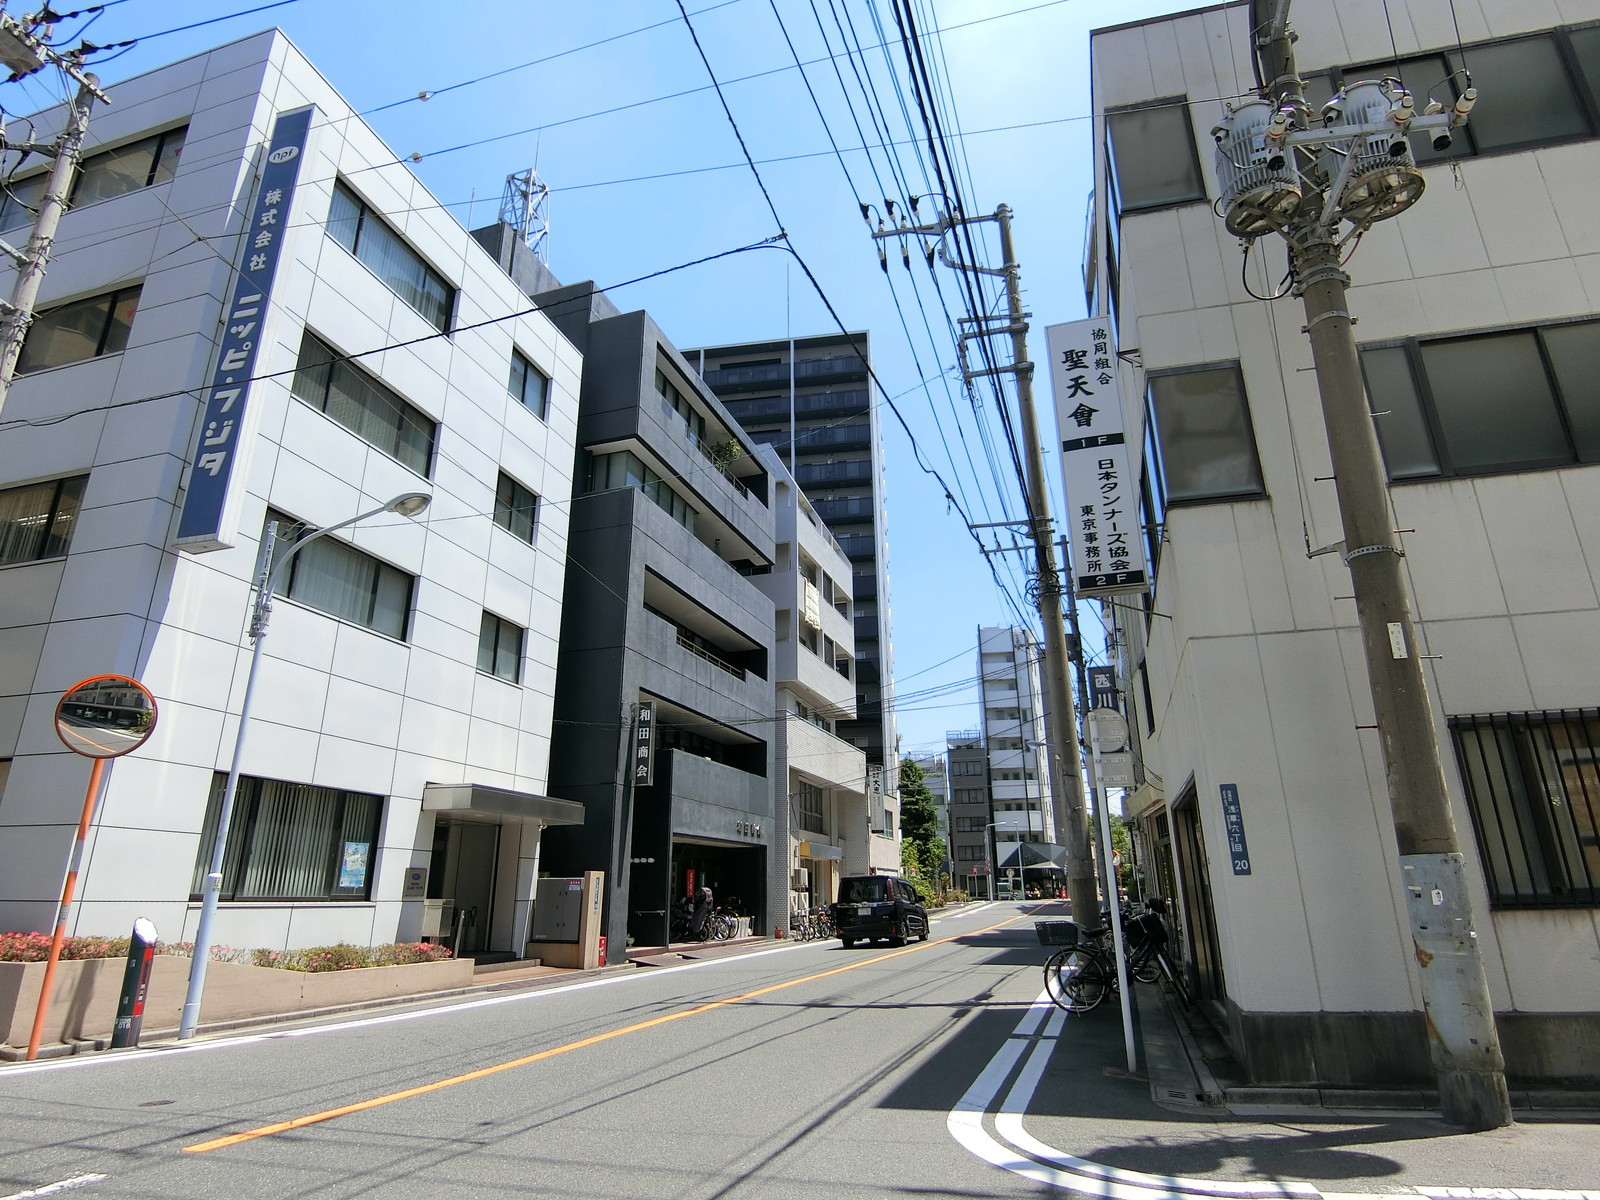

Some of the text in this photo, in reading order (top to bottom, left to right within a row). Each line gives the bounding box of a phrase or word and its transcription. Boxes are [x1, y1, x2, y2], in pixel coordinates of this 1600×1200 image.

[273, 148, 295, 161] npf
[249, 189, 283, 272] 株式会社
[1061, 348, 1100, 428] 聖天會
[1091, 328, 1114, 386] 協同組合
[1080, 504, 1103, 573] 東京事務所
[1097, 458, 1131, 572] 日本タンナーズ協会
[1094, 673, 1113, 709] 西川
[636, 708, 652, 777] 和田商会
[1227, 804, 1243, 852] 浅草六丁目
[1234, 859, 1249, 870] 20
